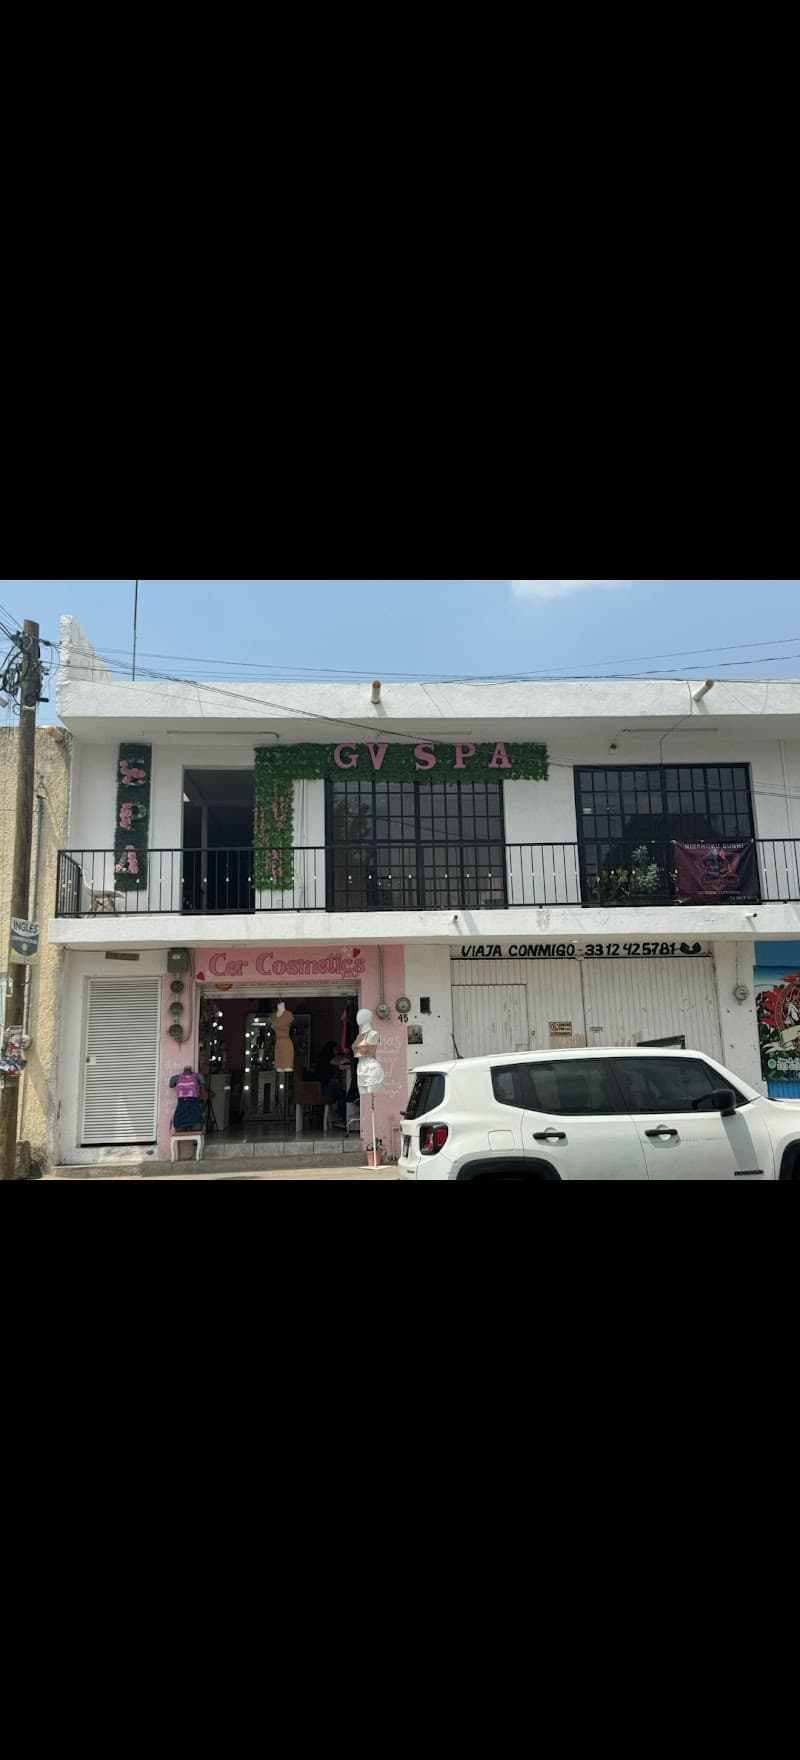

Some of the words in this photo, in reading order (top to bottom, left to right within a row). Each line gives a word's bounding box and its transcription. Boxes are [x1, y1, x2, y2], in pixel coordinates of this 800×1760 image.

[333, 742, 388, 770] GV
[414, 741, 512, 770] SPA
[461, 944, 503, 957] VIAJA
[508, 944, 575, 957] CONMIGO
[397, 1014, 409, 1023] 45
